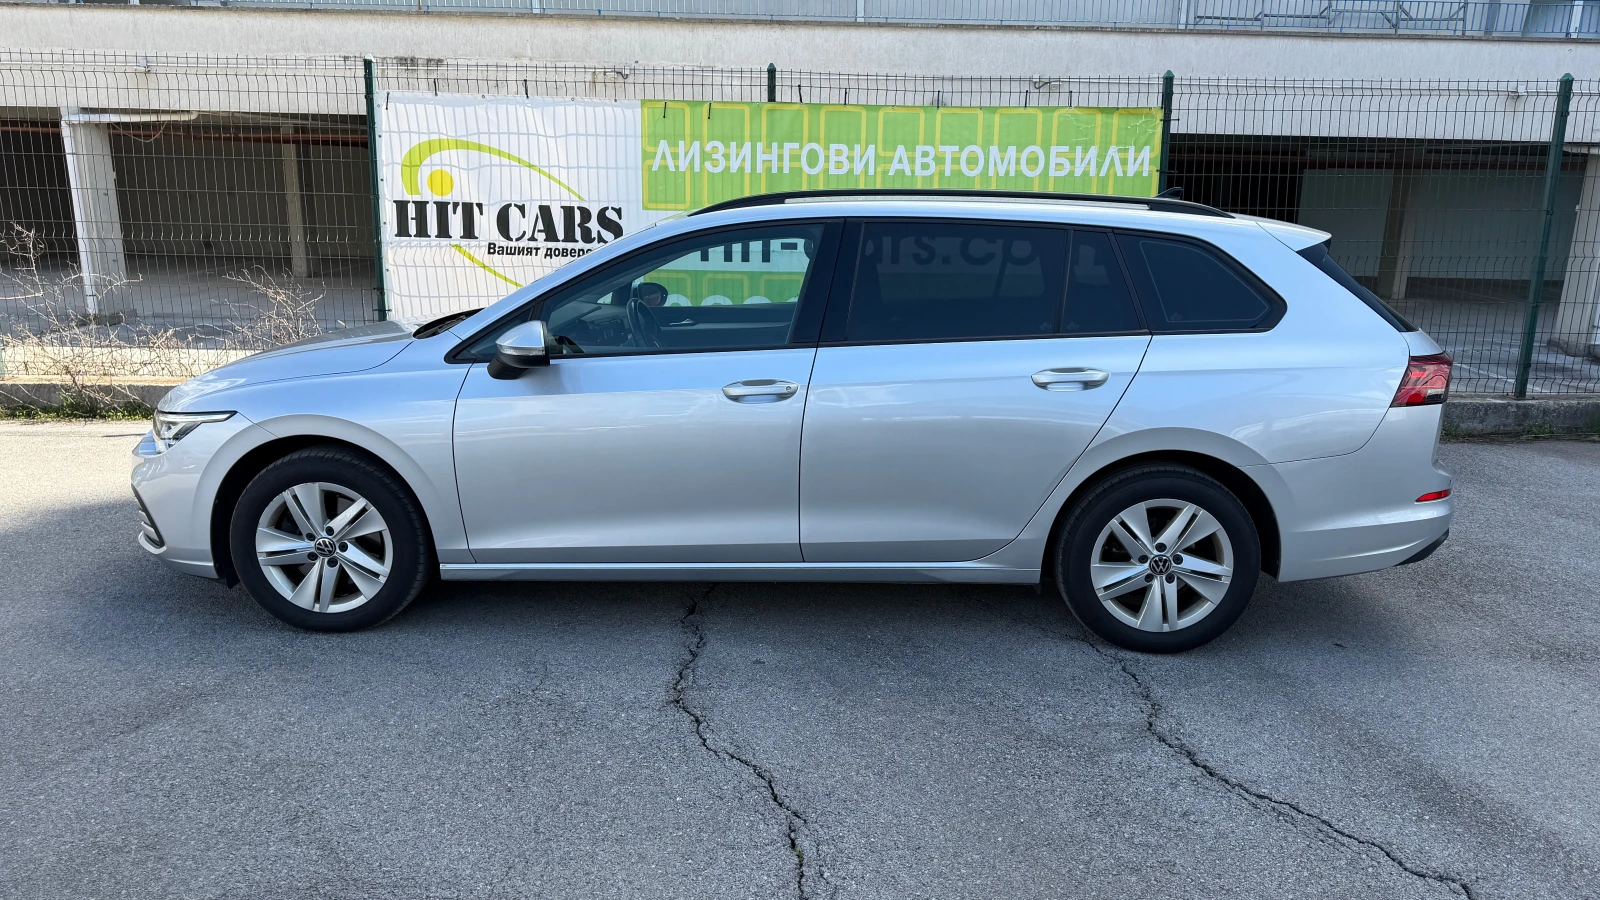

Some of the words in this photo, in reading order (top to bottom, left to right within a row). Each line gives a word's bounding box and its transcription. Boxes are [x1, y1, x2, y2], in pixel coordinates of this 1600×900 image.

[652, 139, 876, 176] ЛИЗИНГОВИ
[889, 144, 1151, 178] АВТОМОБИЛИ
[393, 199, 484, 240] HIT
[496, 202, 623, 244] CARS
[487, 242, 540, 256] Вашият
